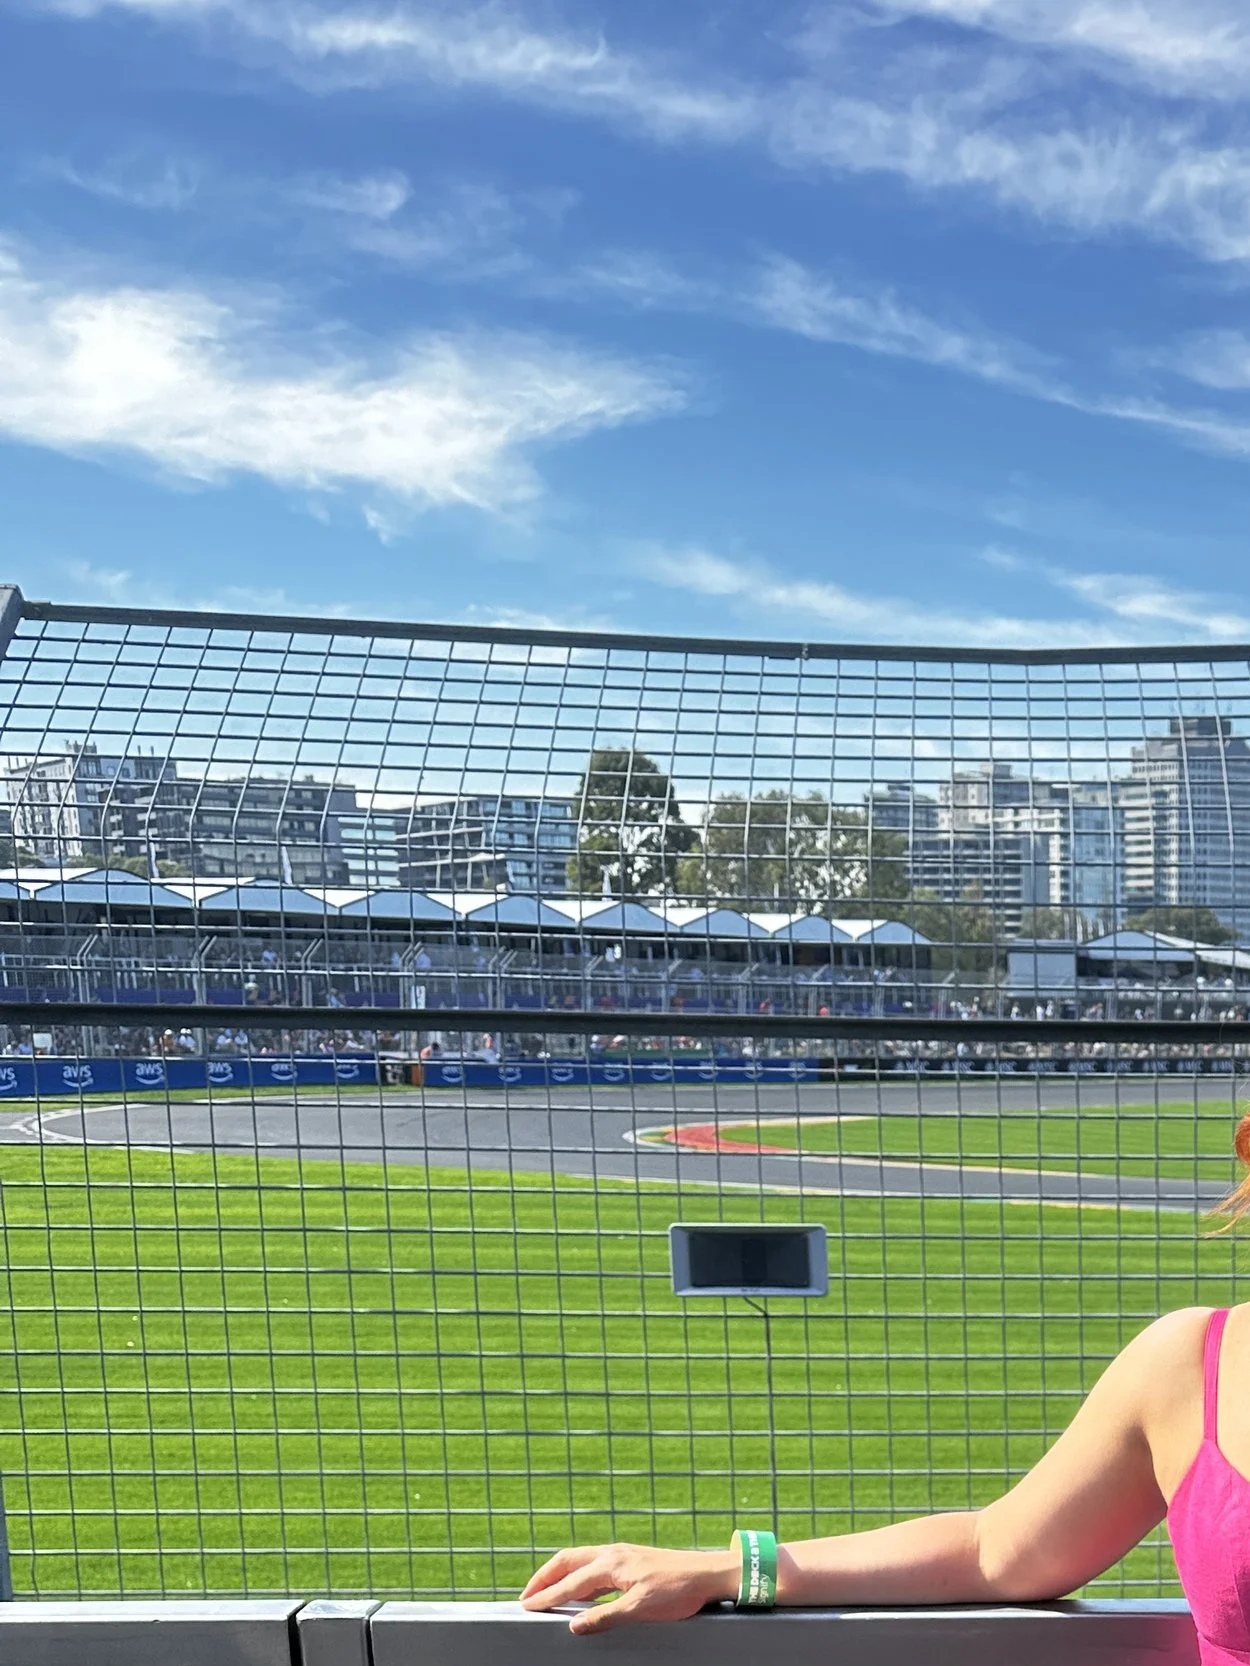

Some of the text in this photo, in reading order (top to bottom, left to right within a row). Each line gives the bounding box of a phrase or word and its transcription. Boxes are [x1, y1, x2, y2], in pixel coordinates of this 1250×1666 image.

[63, 1065, 92, 1079] aws
[135, 1062, 163, 1076] aws
[751, 1556, 760, 1586] DECK
